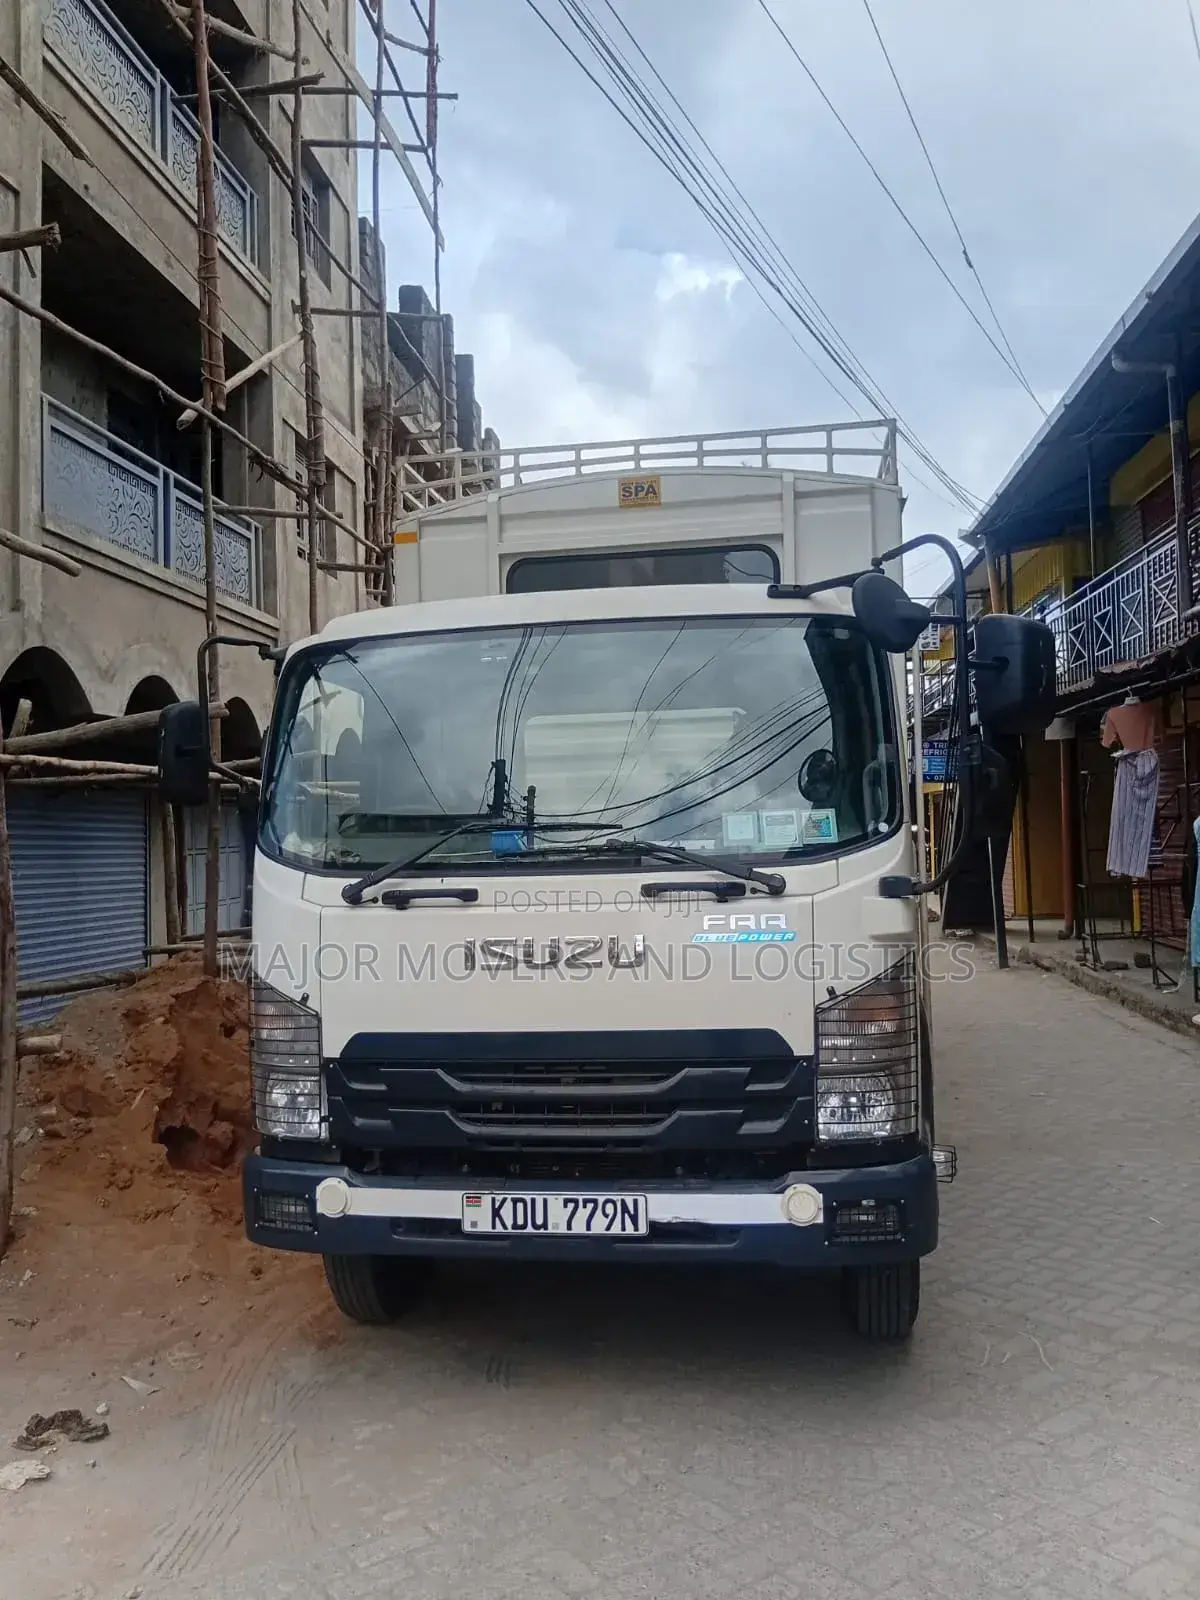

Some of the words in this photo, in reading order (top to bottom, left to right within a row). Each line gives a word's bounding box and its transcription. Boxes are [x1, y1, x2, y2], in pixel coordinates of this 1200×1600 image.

[621, 484, 657, 498] SPA
[703, 913, 787, 930] FRR
[463, 934, 646, 972] ISUZU
[490, 1196, 549, 1231] KDU
[563, 1198, 640, 1233] 779N
